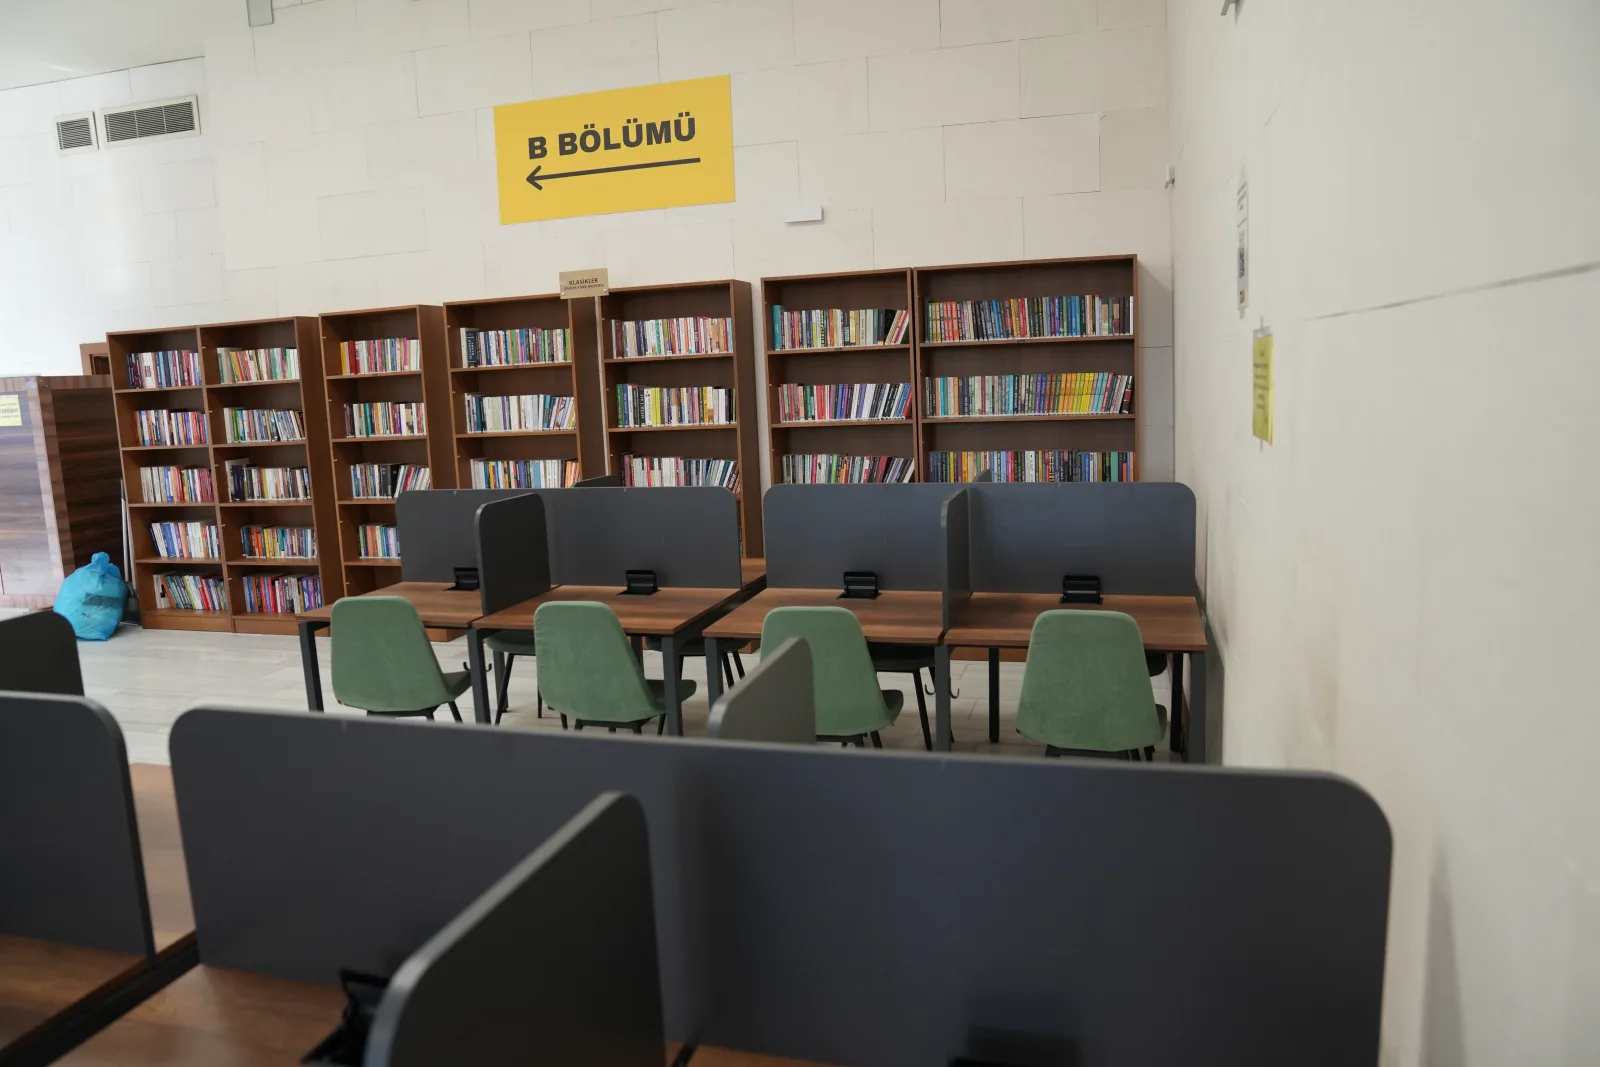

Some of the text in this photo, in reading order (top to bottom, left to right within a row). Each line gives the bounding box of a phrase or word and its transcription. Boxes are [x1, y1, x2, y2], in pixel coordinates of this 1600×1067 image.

[528, 111, 696, 159] B BÖLÜMÜ
[569, 277, 598, 285] KLASİKLER
